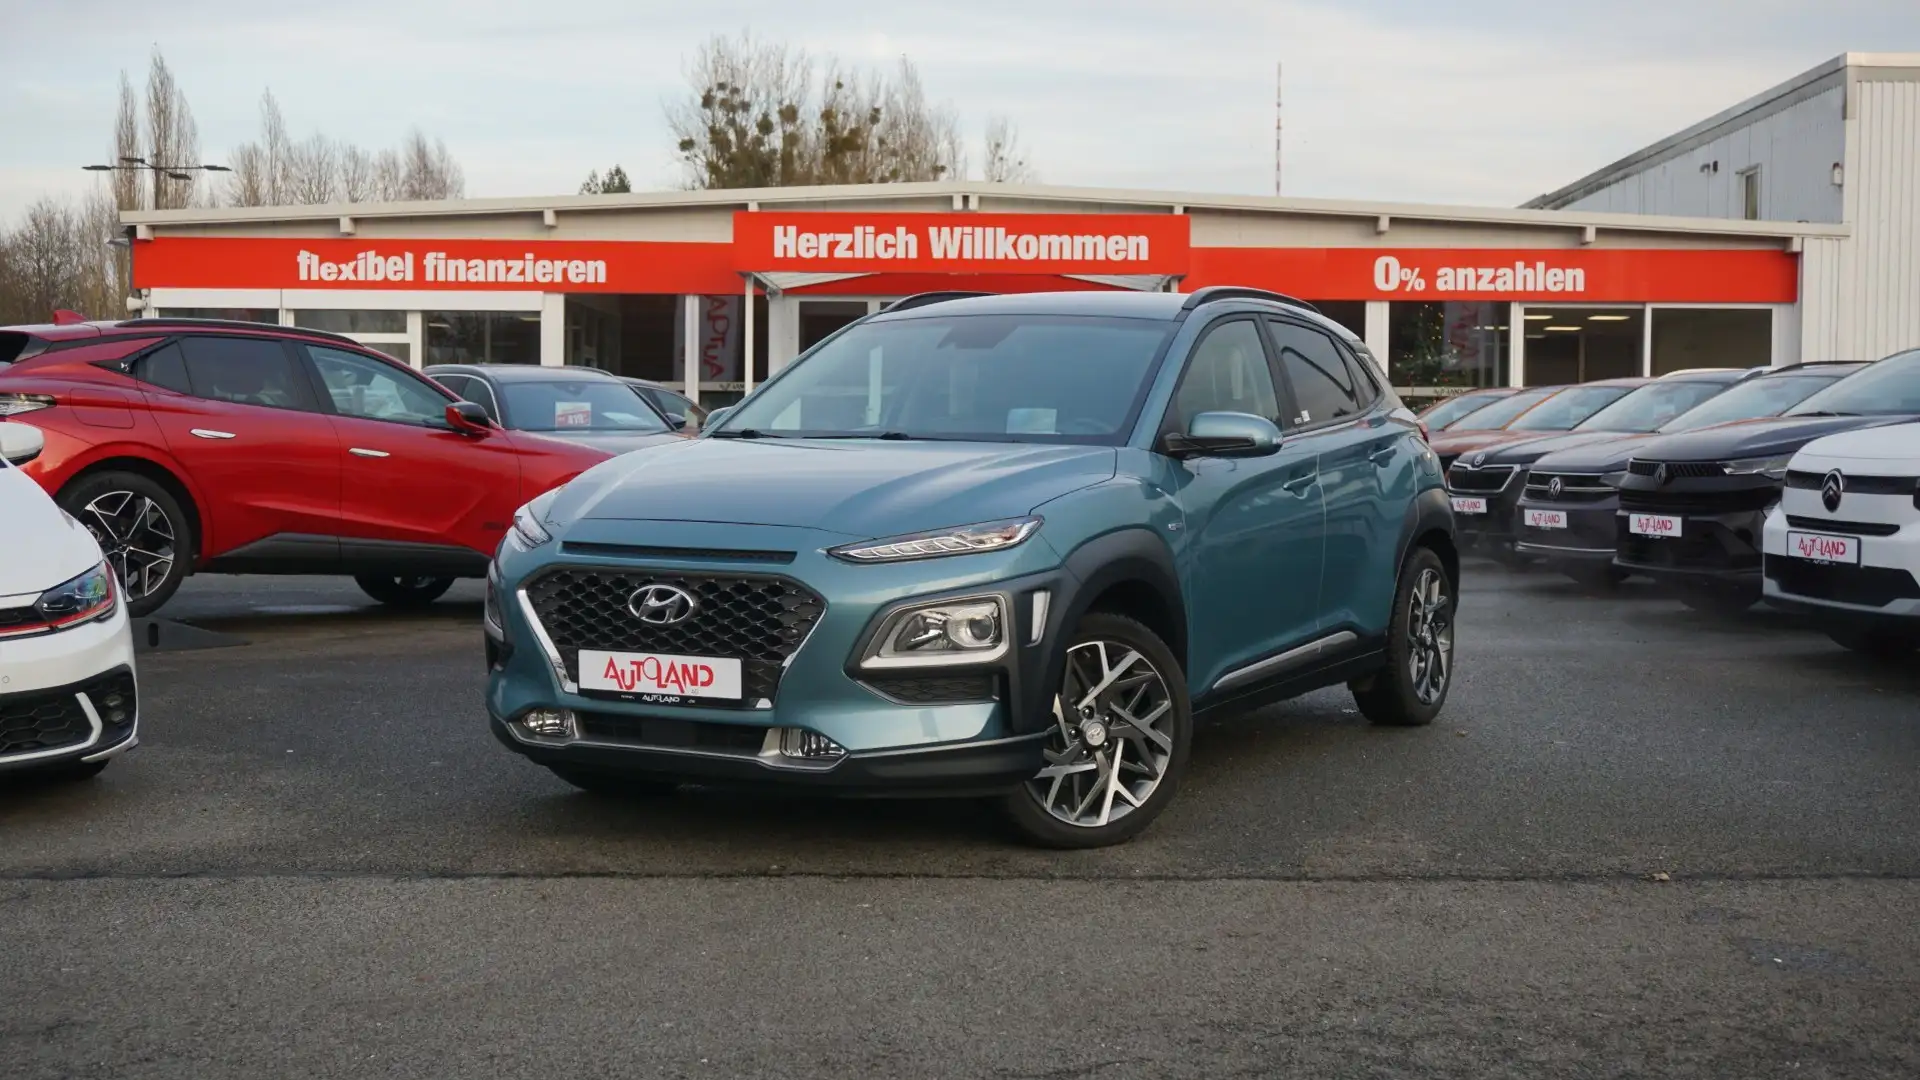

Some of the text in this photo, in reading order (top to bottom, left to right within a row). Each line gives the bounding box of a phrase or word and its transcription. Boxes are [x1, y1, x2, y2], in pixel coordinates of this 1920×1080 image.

[773, 226, 1149, 261] Herzlich Willkommen
[297, 250, 606, 283] flexibel finanzieren
[1373, 256, 1585, 292] 0% anzahlen
[1798, 536, 1846, 559] AUTOLAND
[604, 656, 714, 694] AUTOLAND
